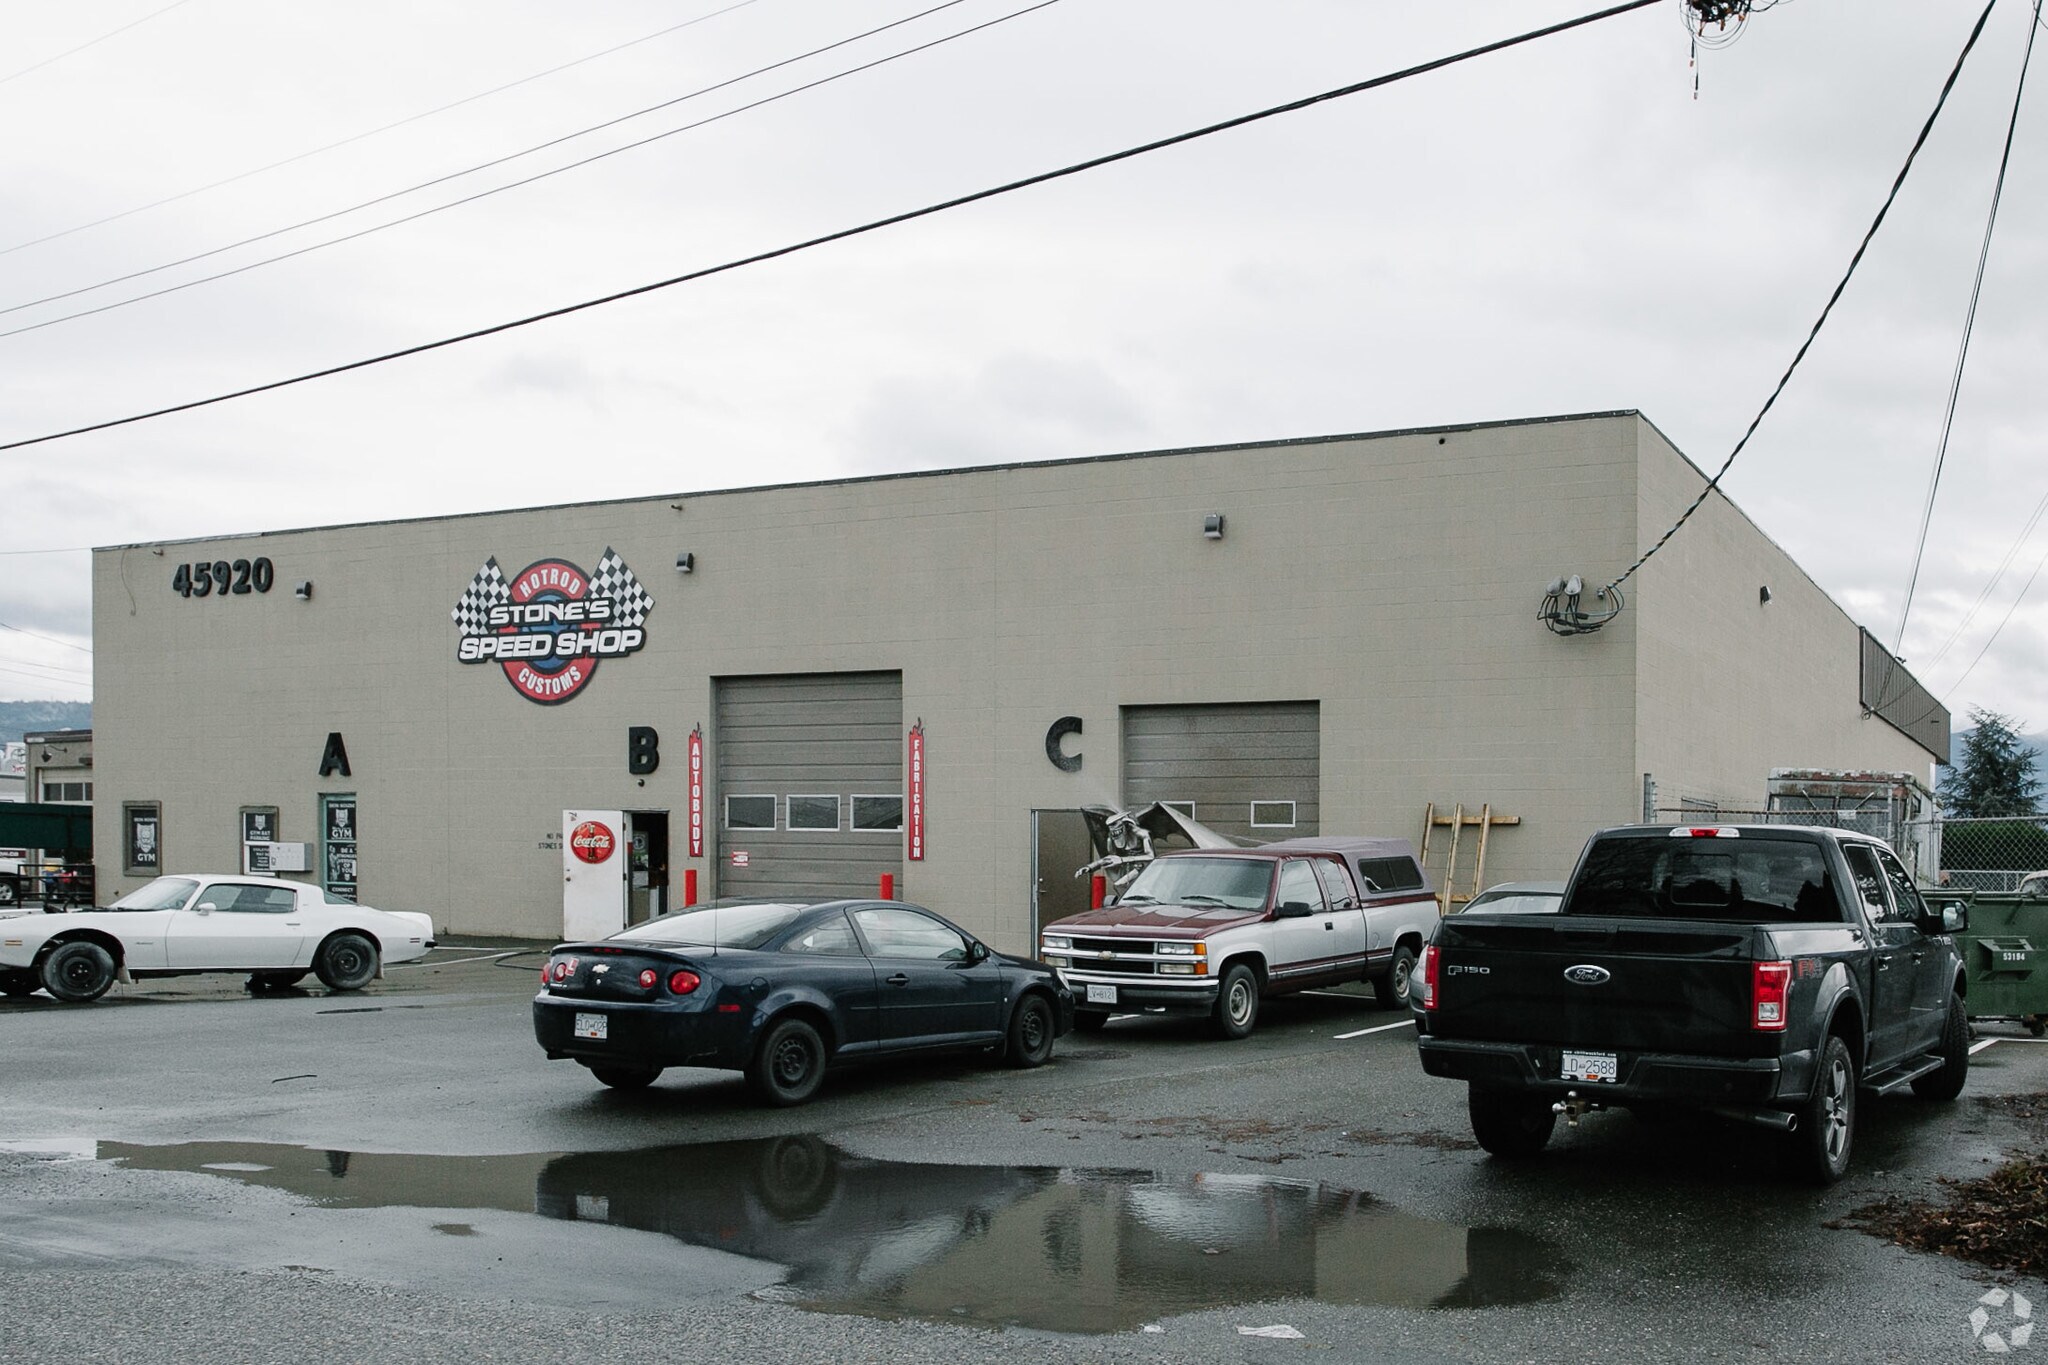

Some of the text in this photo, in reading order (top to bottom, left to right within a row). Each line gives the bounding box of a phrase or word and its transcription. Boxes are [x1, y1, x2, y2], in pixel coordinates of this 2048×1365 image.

[173, 557, 274, 598] 45920
[519, 568, 581, 598] HOTROD
[489, 600, 611, 625] STONE'S
[459, 629, 642, 660] SPEED SHOP
[518, 665, 582, 695] CUSTOMS
[318, 732, 352, 777] A
[628, 726, 660, 775] B
[1045, 716, 1083, 773] C
[691, 742, 701, 855] AUTOBODY
[912, 738, 922, 858] FABRICATION
[332, 829, 352, 838] GYM
[137, 853, 156, 861] GYM
